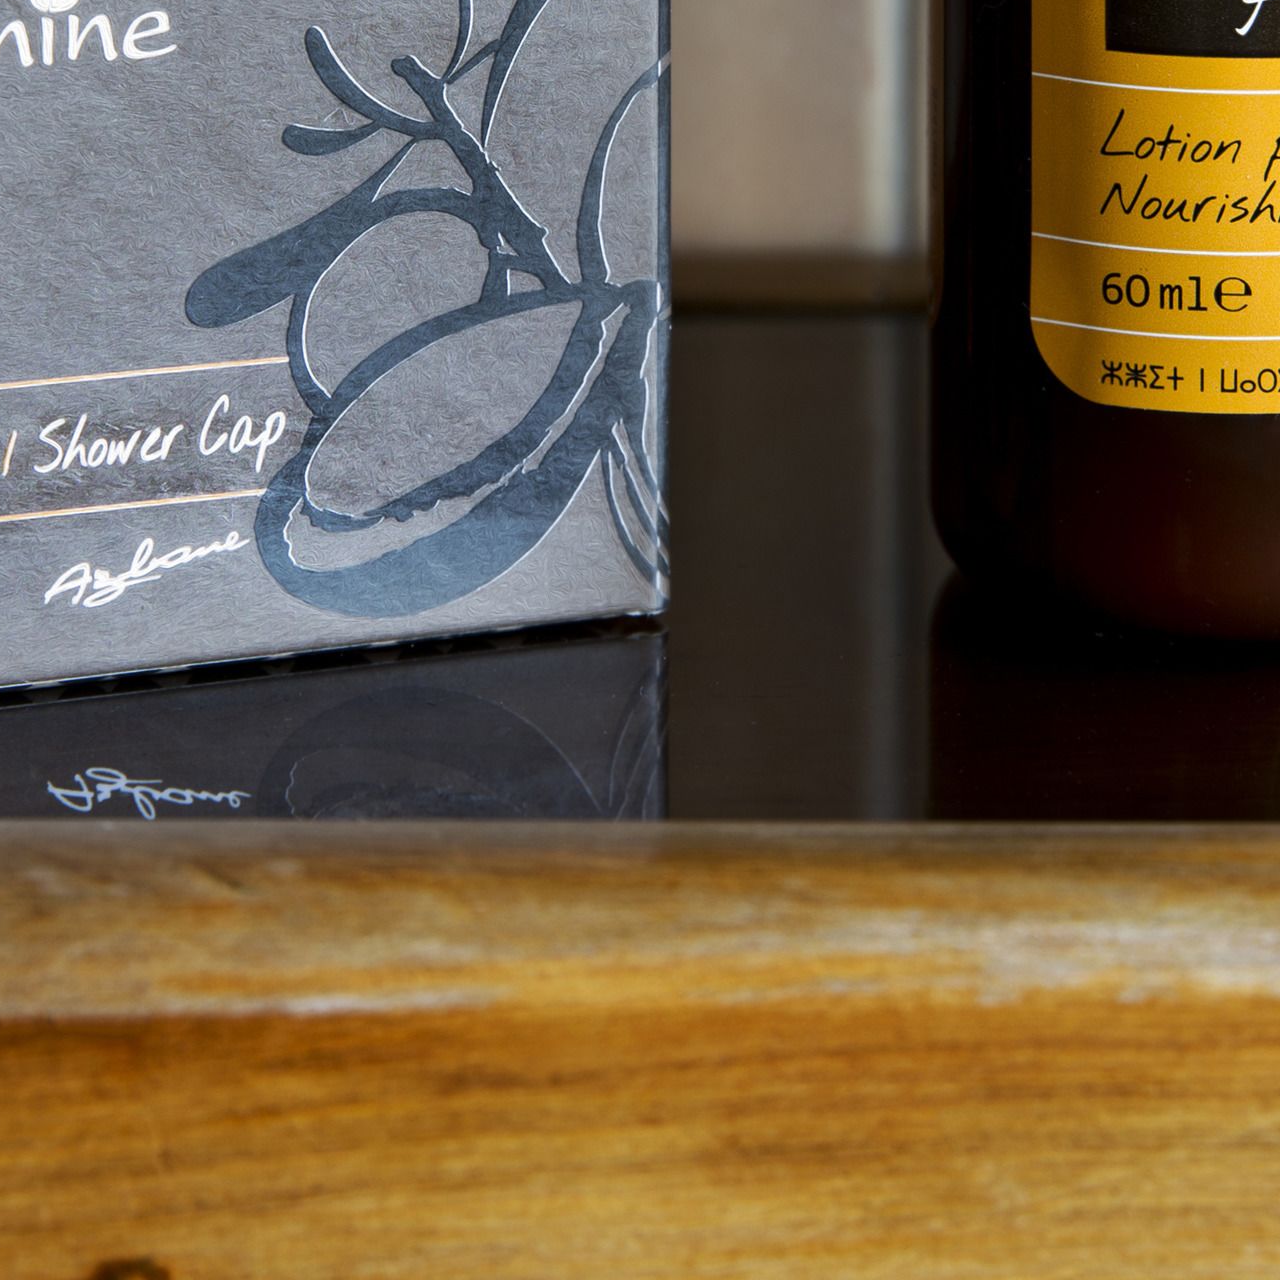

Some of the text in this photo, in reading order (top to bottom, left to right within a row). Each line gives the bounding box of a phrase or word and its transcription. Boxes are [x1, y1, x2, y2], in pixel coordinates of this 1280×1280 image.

[1100, 108, 1242, 164] Lotion
[34, 414, 179, 475] Shower
[197, 393, 289, 474] Cap
